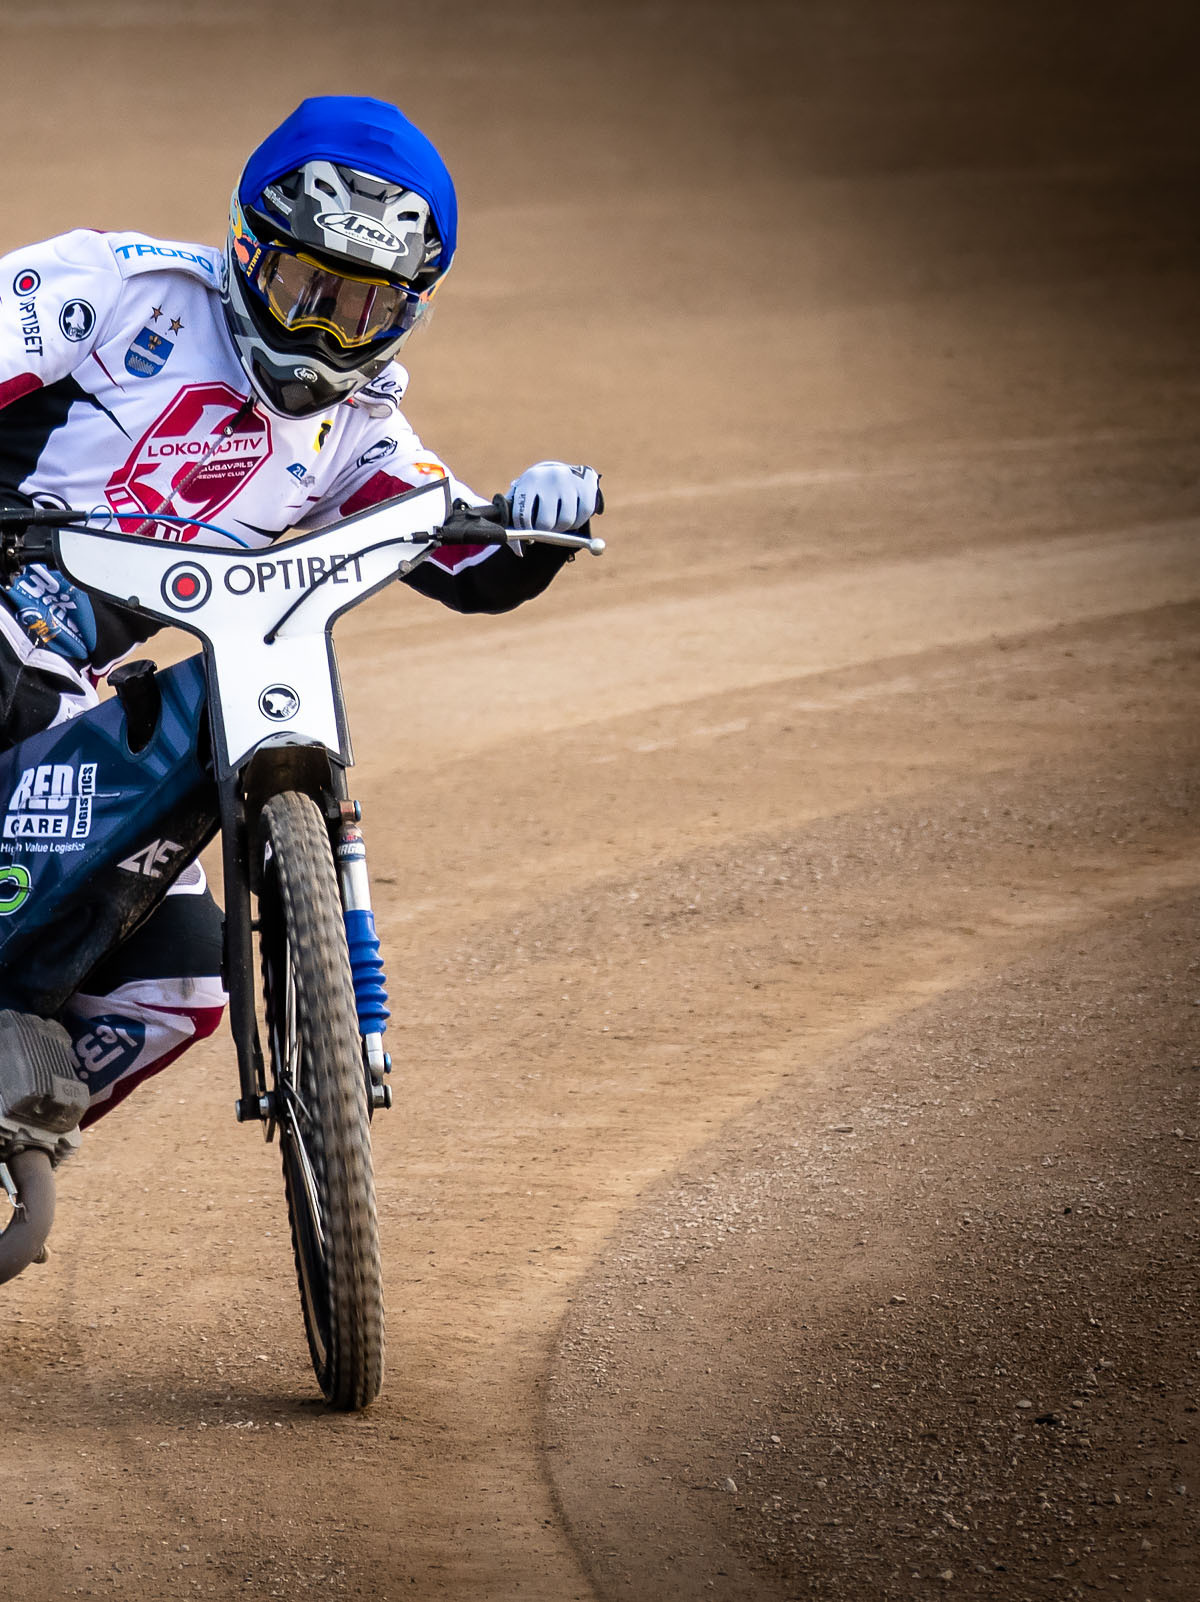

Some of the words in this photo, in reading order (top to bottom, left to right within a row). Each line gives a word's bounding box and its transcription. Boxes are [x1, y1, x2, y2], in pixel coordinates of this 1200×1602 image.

[336, 215, 395, 247] Arai
[246, 247, 262, 278] OAKLEY
[147, 437, 263, 457] LOKOMOTIV
[201, 460, 254, 472] AUGAVPILS
[223, 554, 365, 596] OPTIBET
[8, 764, 74, 811] RED
[10, 817, 63, 835] CARE
[25, 841, 48, 853] Value
[49, 842, 86, 855] Logistics
